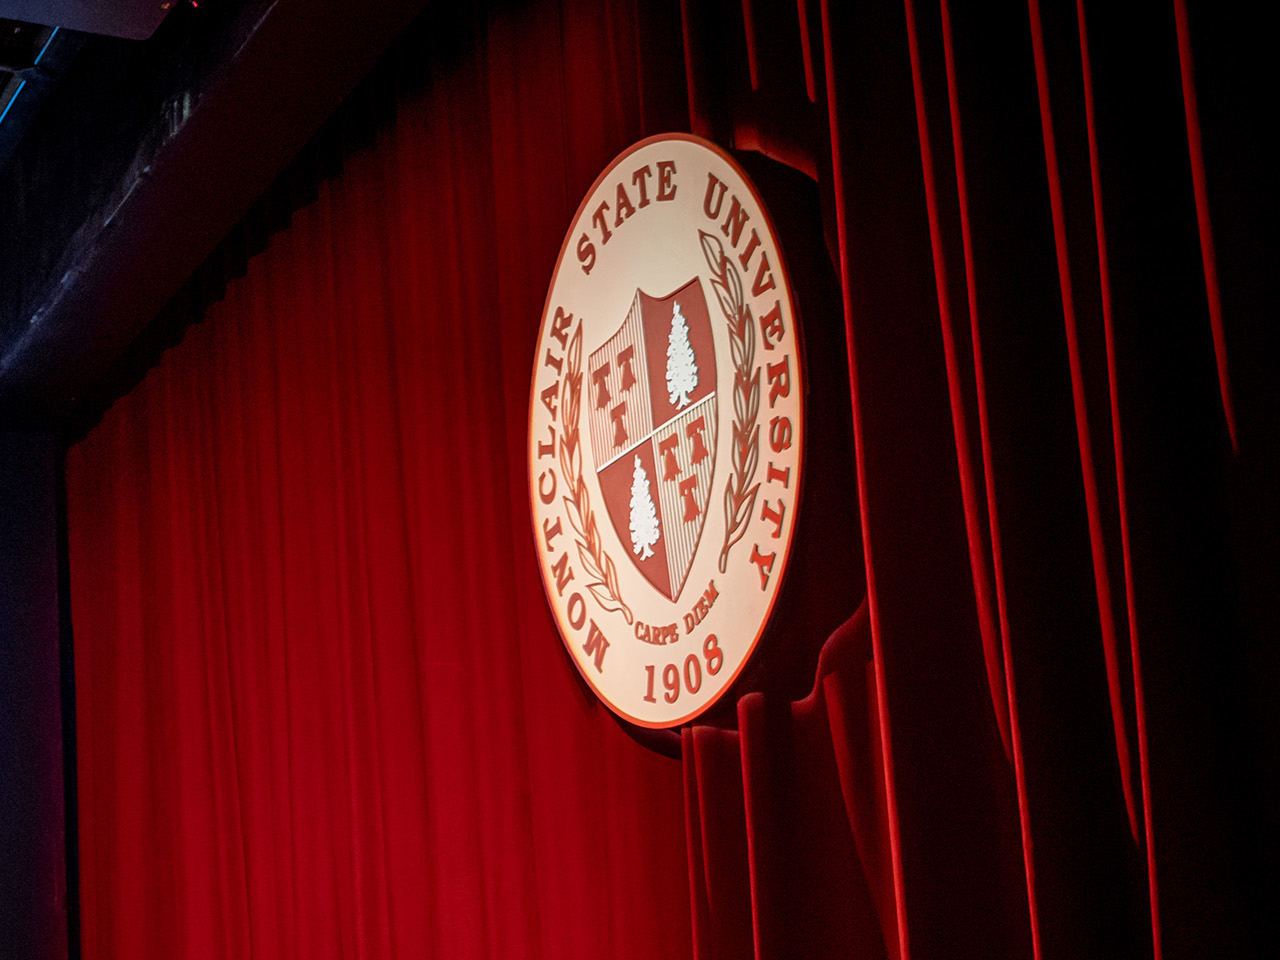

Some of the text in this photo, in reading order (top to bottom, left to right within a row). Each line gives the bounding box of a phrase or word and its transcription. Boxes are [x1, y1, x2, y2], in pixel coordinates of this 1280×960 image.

[538, 161, 793, 674] MONTCLAIR STATE UNIVERSITY
[634, 580, 719, 645] CARPE DIEM
[643, 634, 724, 704] 1908
